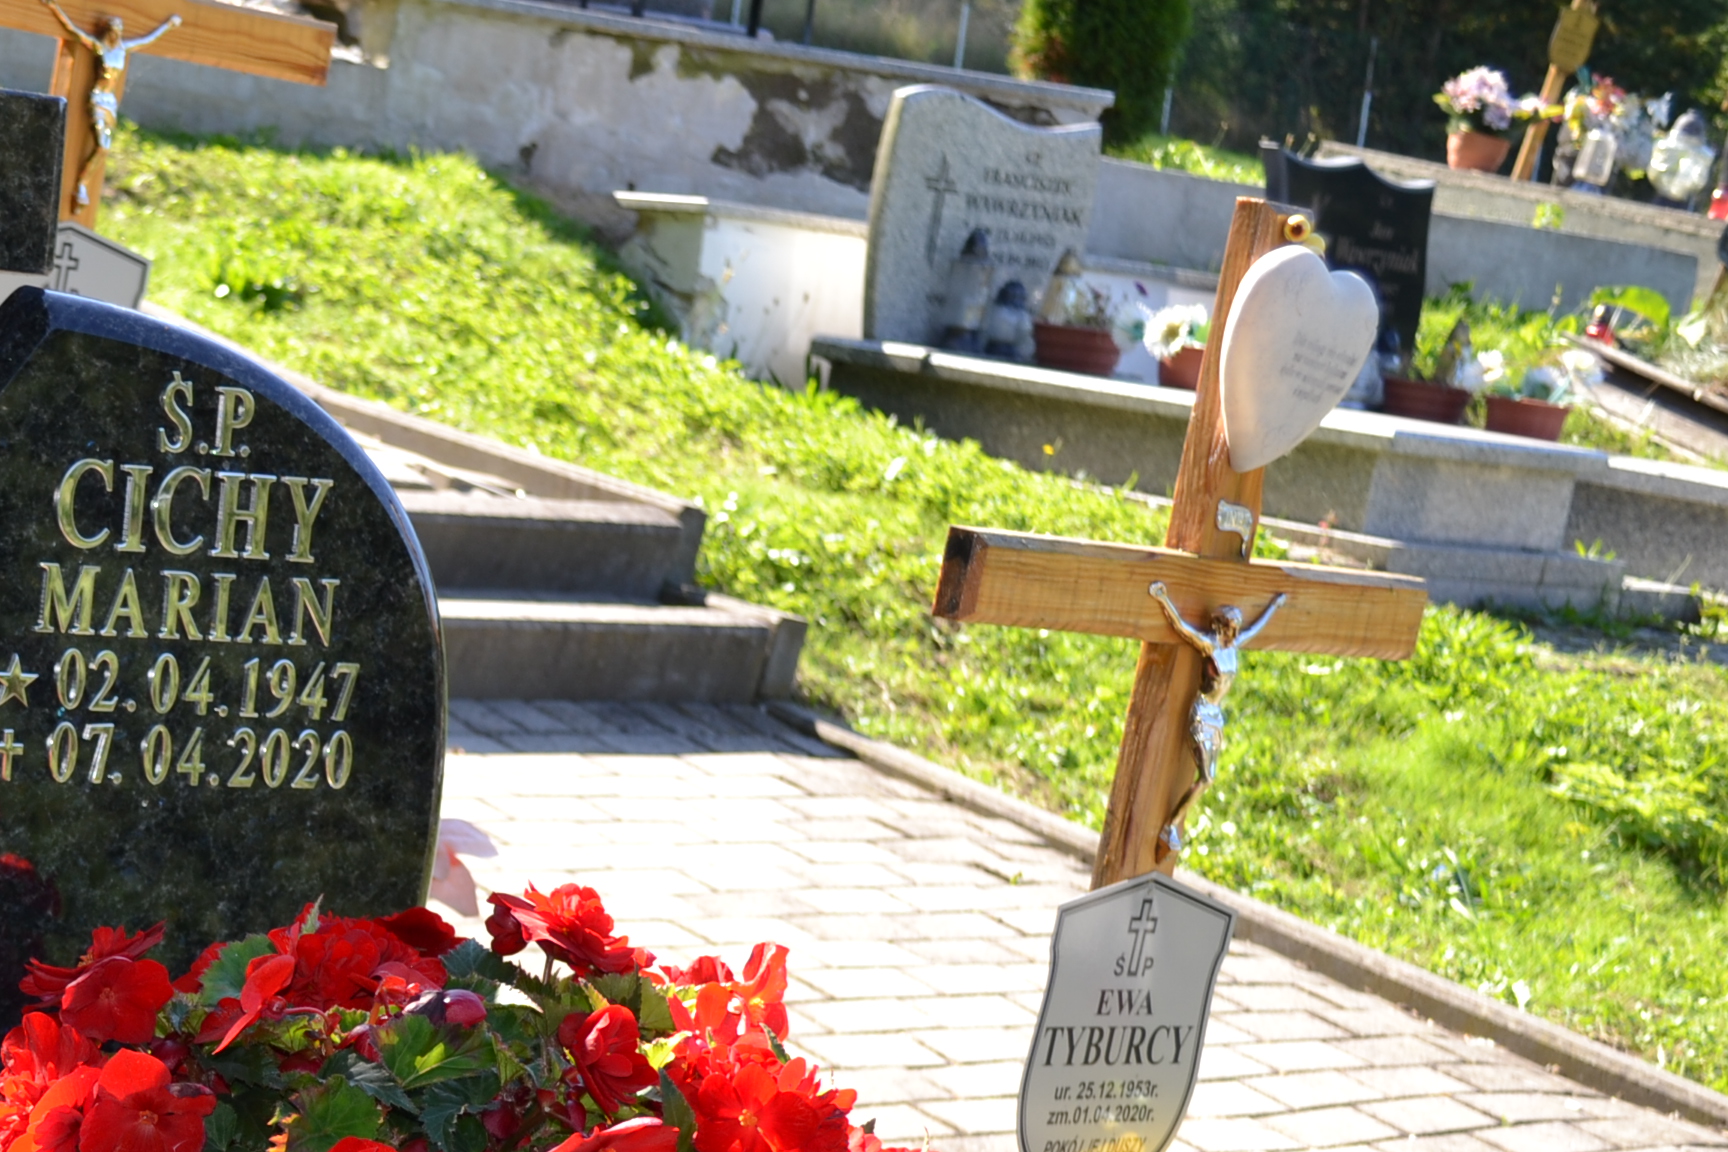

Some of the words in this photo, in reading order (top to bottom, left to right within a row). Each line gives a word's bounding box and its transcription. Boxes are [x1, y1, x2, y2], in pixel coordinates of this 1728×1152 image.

[53, 458, 334, 563] CICHY
[32, 562, 340, 648] MARIAN
[1141, 956, 1154, 977] P
[1096, 989, 1153, 1016] EWA
[1043, 1025, 1194, 1066] TYBURCY
[1054, 1085, 1071, 1100] ur.
[1076, 1079, 1158, 1100] 25.12.1953r.
